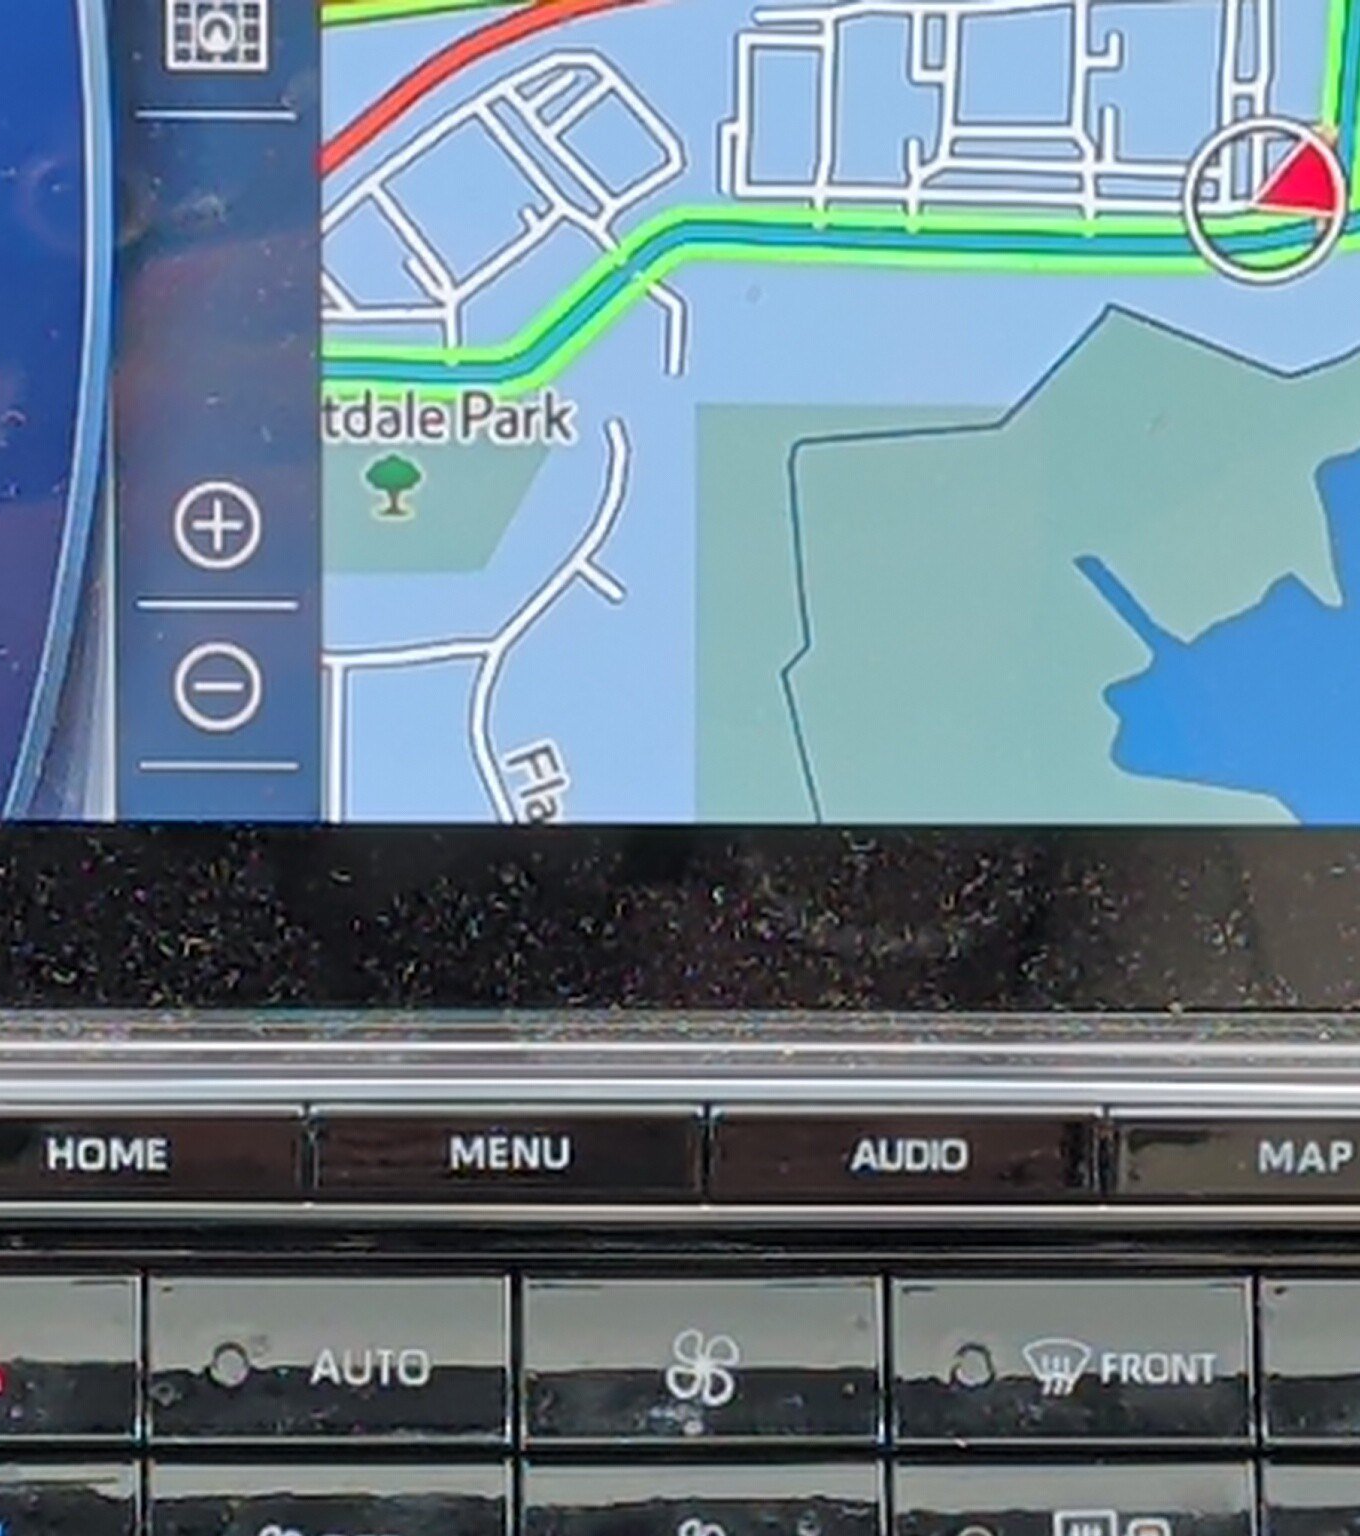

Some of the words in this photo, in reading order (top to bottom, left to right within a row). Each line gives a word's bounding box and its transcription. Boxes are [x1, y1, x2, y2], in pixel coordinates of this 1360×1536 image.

[461, 392, 573, 440] Park
[46, 1137, 168, 1172] HOME
[450, 1136, 570, 1170] MENU
[851, 1139, 968, 1172] AUDIO
[1258, 1140, 1352, 1173] MAP
[310, 1349, 430, 1387] AUTO
[1101, 1353, 1216, 1384] FRONT
